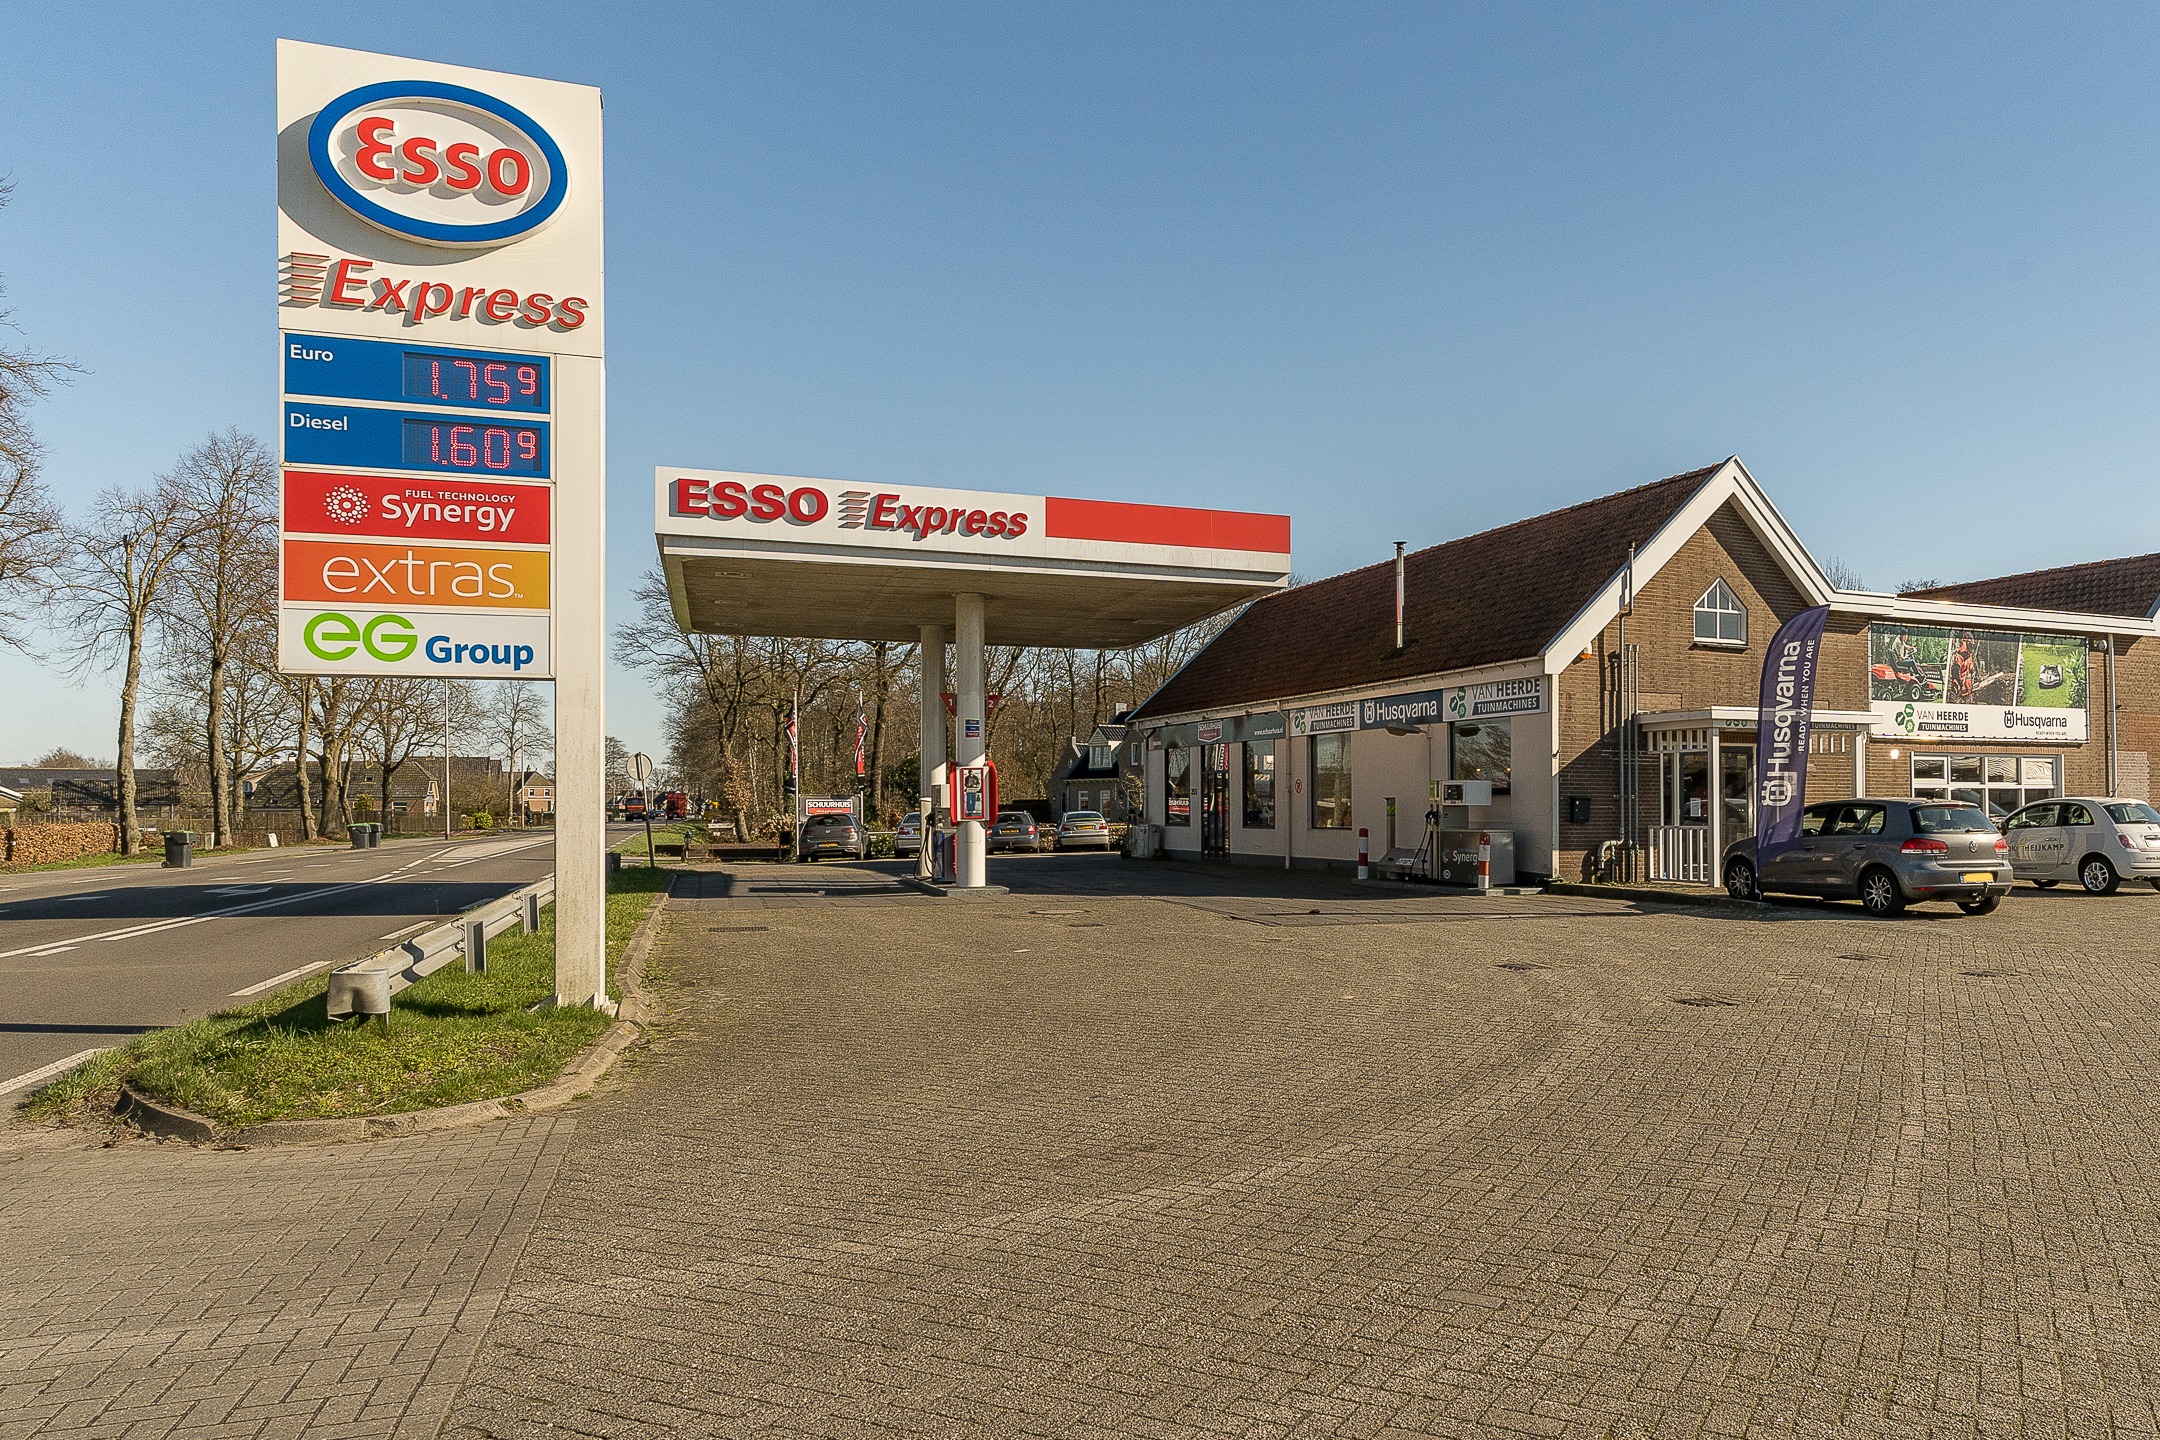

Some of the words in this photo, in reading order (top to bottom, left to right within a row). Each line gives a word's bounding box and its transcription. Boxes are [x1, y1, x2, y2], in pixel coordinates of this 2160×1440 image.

[330, 258, 587, 329] Express
[290, 344, 334, 362] Euro
[290, 413, 348, 432] Diesel
[405, 489, 435, 500] FUEL
[438, 491, 516, 504] TECHNOLOGY
[381, 494, 516, 532] Synergy
[872, 493, 1029, 541] Express
[322, 550, 515, 599] extras
[425, 636, 534, 671] Group
[1806, 639, 1815, 659] ARE
[1803, 661, 1811, 682] YOU
[1471, 684, 1493, 700] VAN
[1496, 678, 1541, 697] HEERDE
[948, 698, 953, 706] 1
[988, 700, 994, 708] 2
[1477, 698, 1537, 714] TUINMACHINES
[1767, 641, 1801, 777] Husqvarna
[1800, 685, 1809, 716] WHEN
[1309, 706, 1324, 719] VAN
[1325, 703, 1355, 717] HEERDE
[1376, 700, 1437, 724] Husqvarna
[1917, 709, 1935, 720] VAN
[1936, 711, 1969, 722] HEERDE
[2016, 712, 2067, 728] Husqvarna
[1312, 718, 1353, 729] TUINMACHINES
[1812, 722, 1856, 730] TUINMACHINES
[1921, 723, 1967, 732] TUINMACHINES
[1798, 720, 1807, 752] READY
[2024, 843, 2065, 852] HEIJKAMP
[1452, 850, 1479, 866] Synerg
